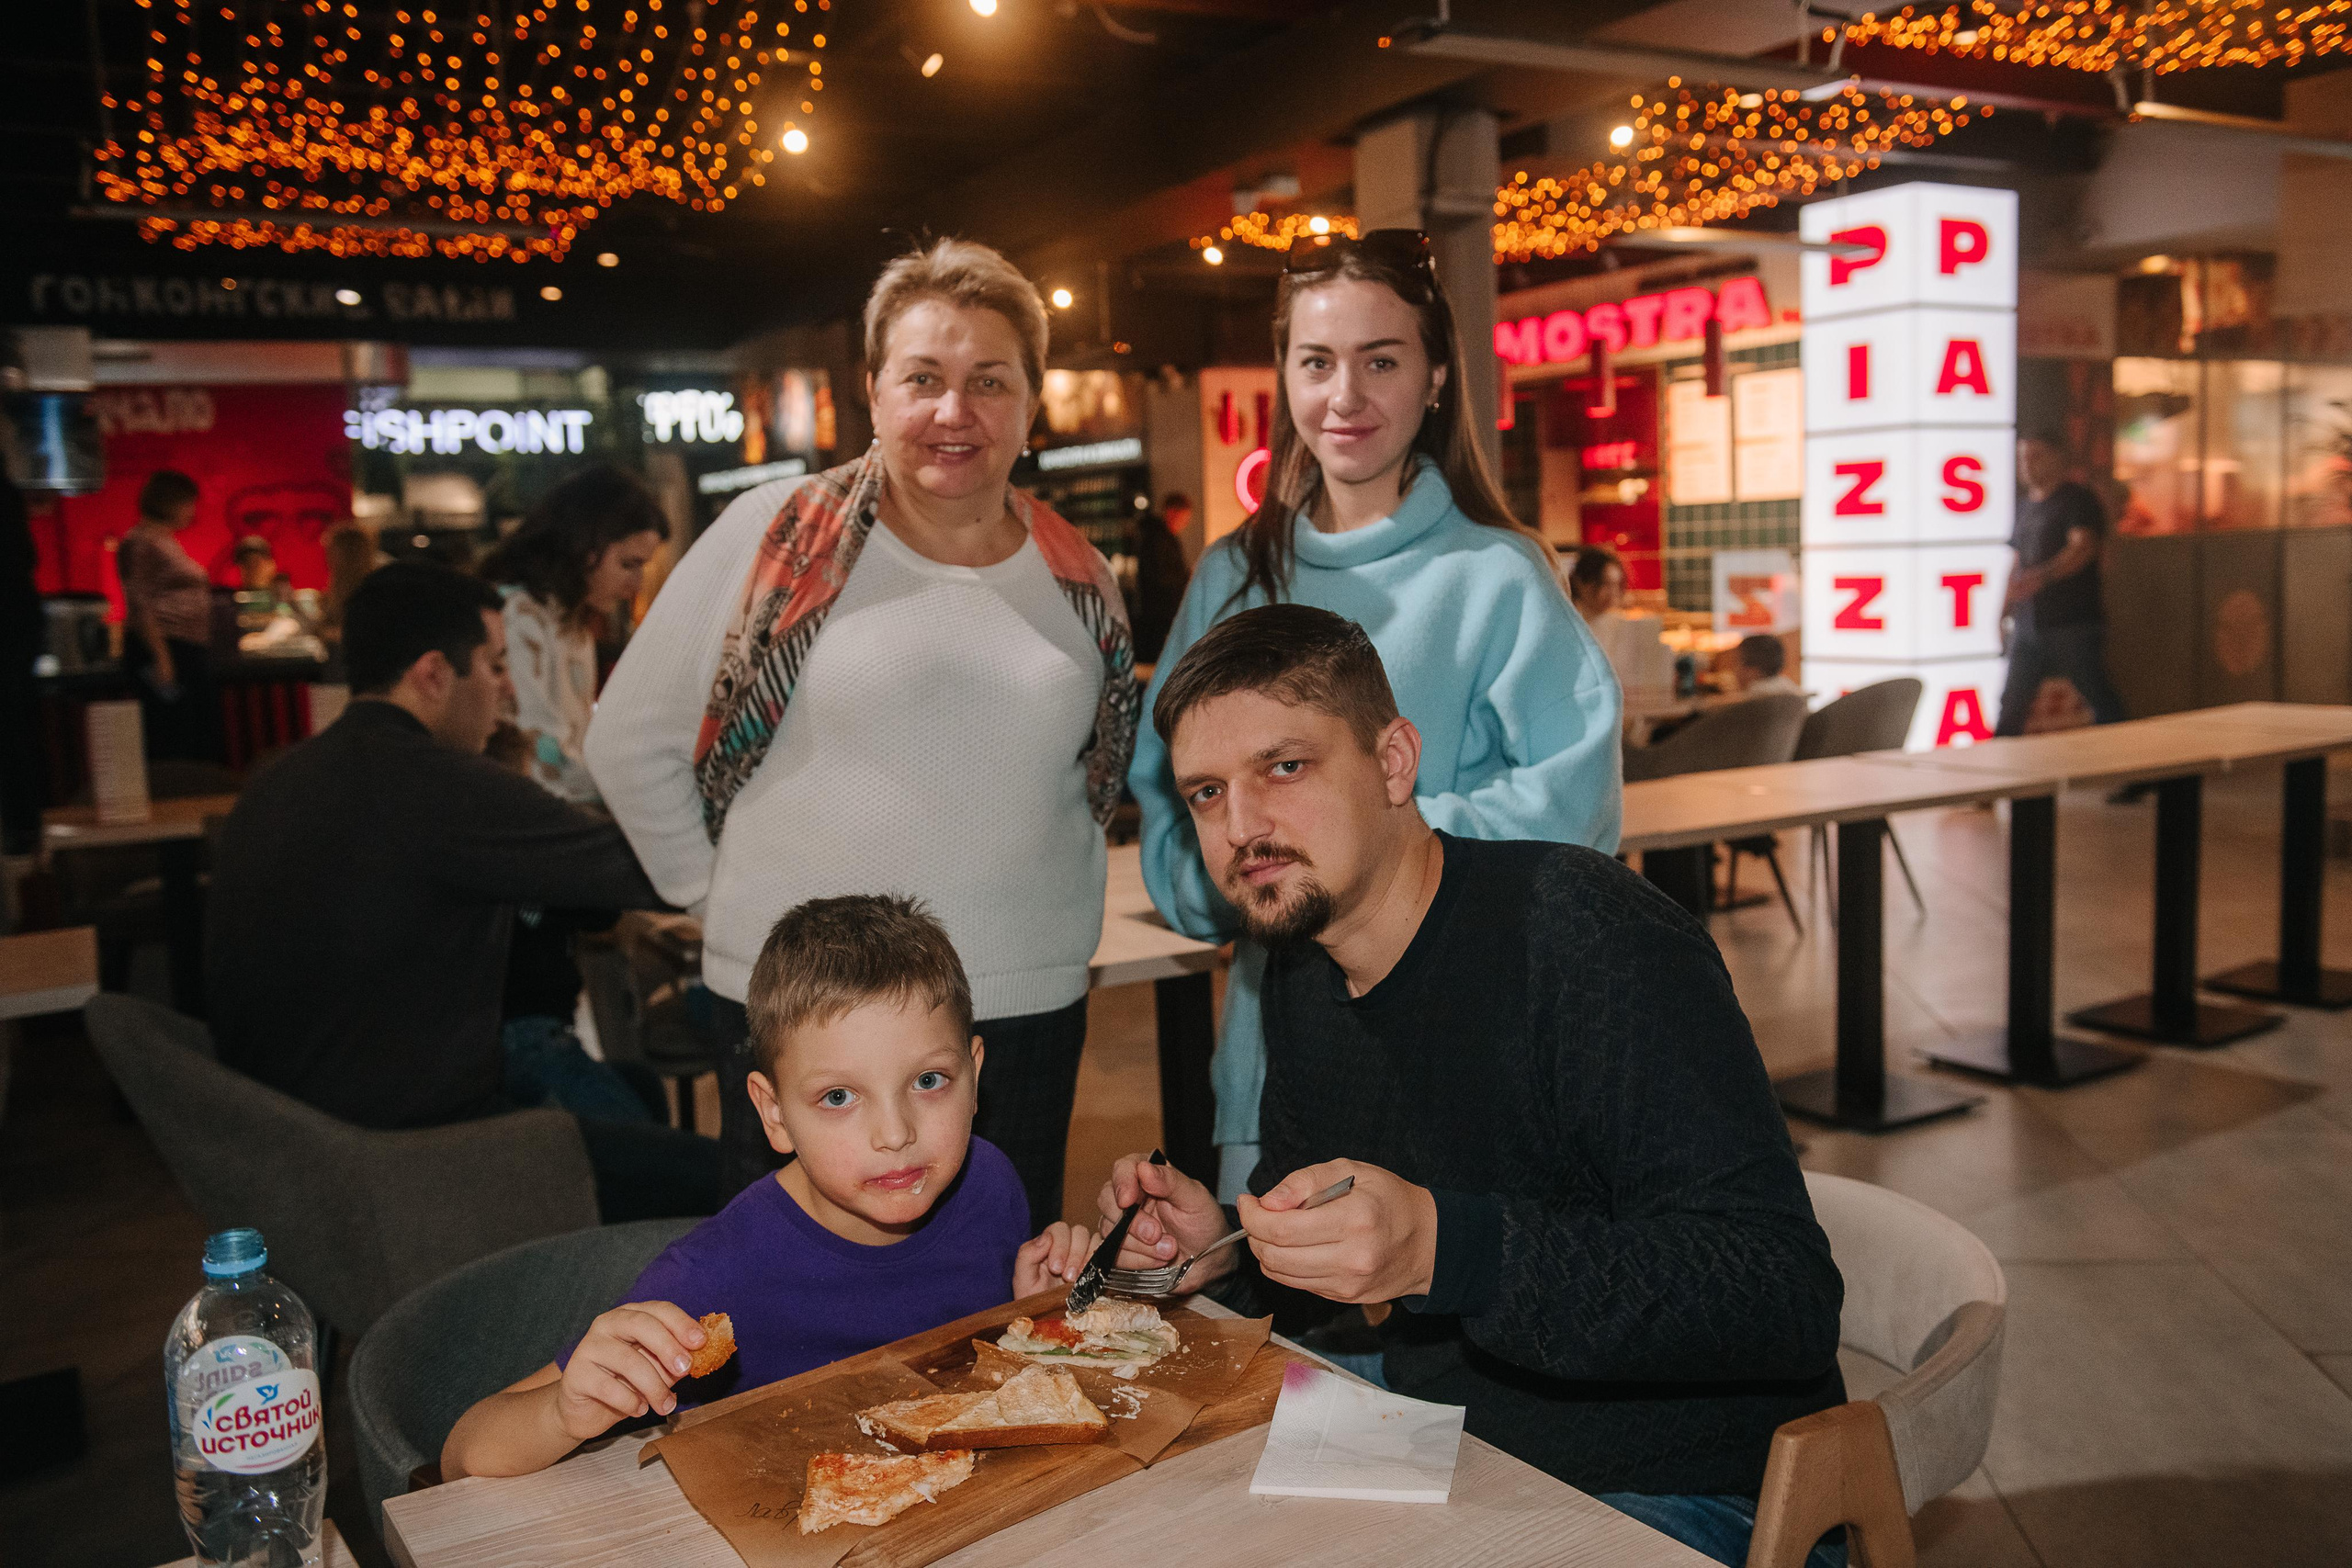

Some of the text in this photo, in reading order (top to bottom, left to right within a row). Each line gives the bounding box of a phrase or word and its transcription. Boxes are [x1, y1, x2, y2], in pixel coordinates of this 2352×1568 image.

[1494, 276, 1770, 366] MOSTRA
[1829, 225, 1887, 695] PIZZ
[1935, 219, 1995, 747] PASTA
